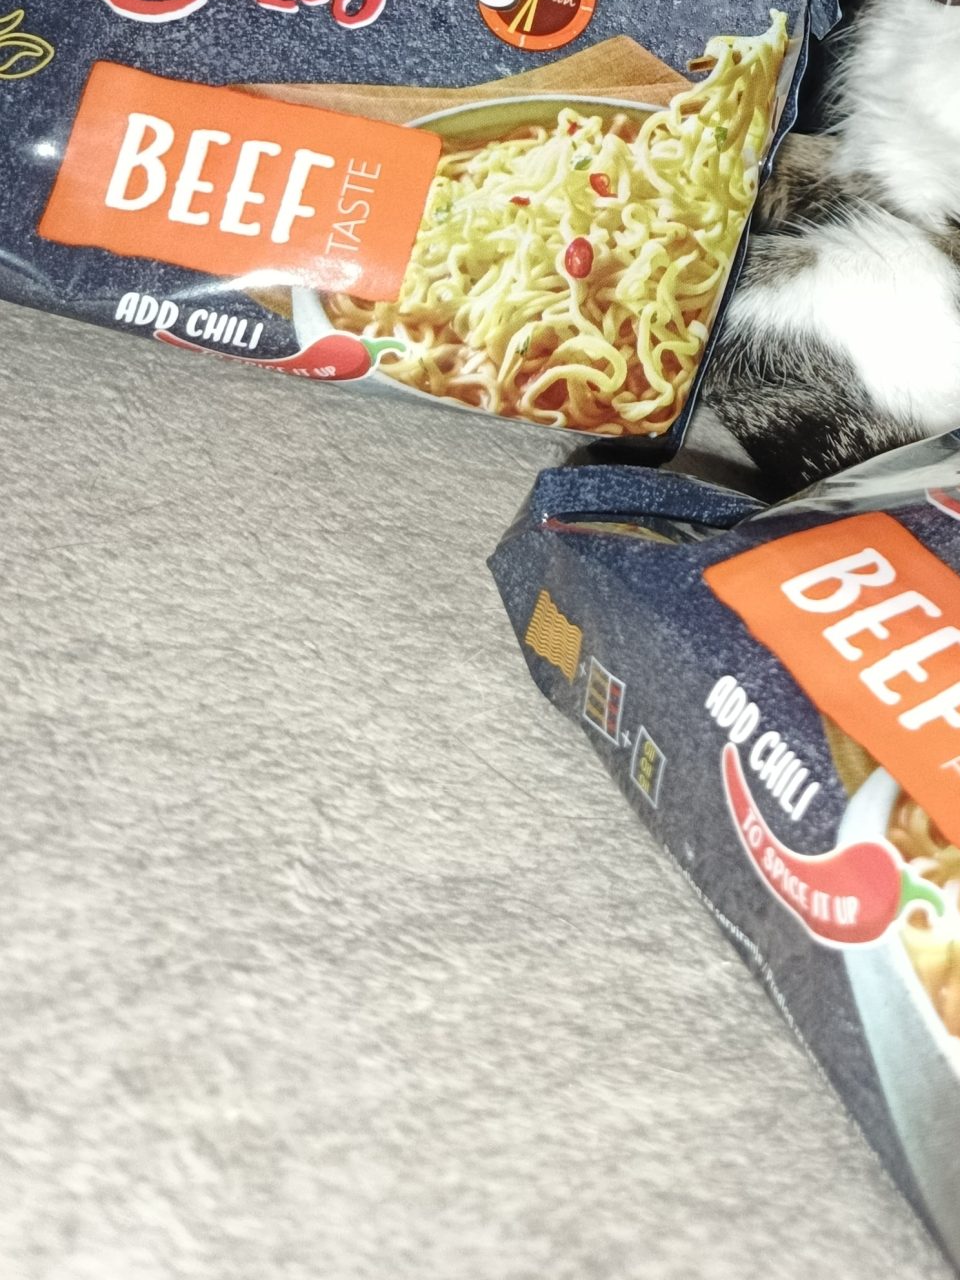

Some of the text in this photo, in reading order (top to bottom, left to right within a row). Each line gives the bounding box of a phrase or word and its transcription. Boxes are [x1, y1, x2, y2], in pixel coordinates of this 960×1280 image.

[105, 112, 336, 244] BEEF
[324, 158, 382, 255] TASTE
[114, 292, 264, 350] ADD CHILI
[314, 365, 337, 378] UP
[704, 674, 821, 822] ADD CHILI
[763, 846, 811, 910] SPICE
[812, 889, 831, 922] IT
[834, 895, 860, 925] UP
